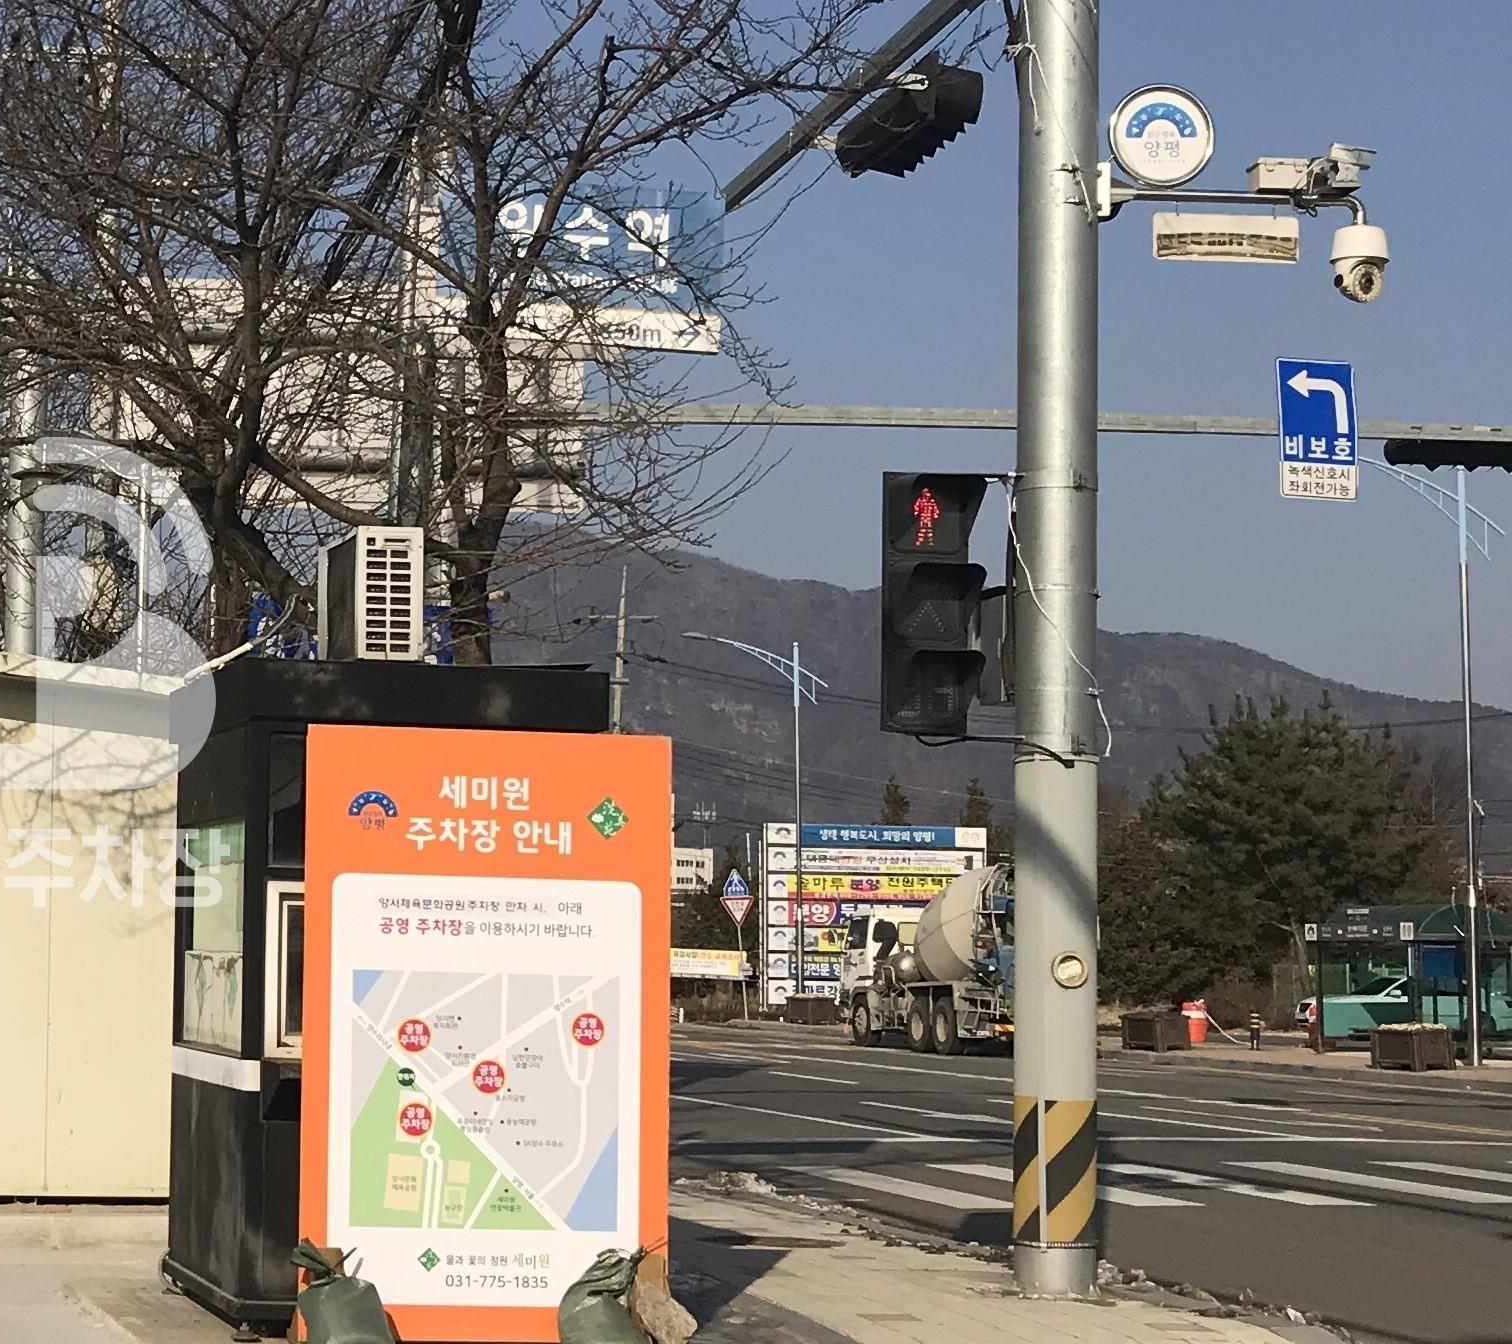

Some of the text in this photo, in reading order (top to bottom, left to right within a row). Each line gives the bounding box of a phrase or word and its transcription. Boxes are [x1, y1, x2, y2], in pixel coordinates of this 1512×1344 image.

[1144, 140, 1180, 158] 양평
[1285, 434, 1354, 461] 비보호
[1288, 481, 1351, 497] 좌회전가능
[438, 775, 530, 811] 세미원
[405, 817, 572, 855] 주차장 안내
[850, 878, 881, 891] 분양
[558, 902, 583, 916] 아래
[379, 916, 409, 935] 공영
[416, 918, 476, 937] 주차장을
[479, 922, 540, 937] 이용하시기
[404, 1022, 424, 1035] 공영
[577, 1016, 598, 1029] 공영
[400, 1034, 429, 1047] 주차장
[574, 1028, 603, 1041] 주차장
[479, 1064, 499, 1077] 공영
[475, 1075, 504, 1088] 주차장
[405, 1107, 425, 1119] 공영
[402, 1118, 430, 1130] 주차장
[468, 1255, 486, 1266] 꽃의
[490, 1256, 508, 1267] 정원
[512, 1253, 550, 1270] 세미원
[445, 1274, 548, 1289] 031-775-1835
